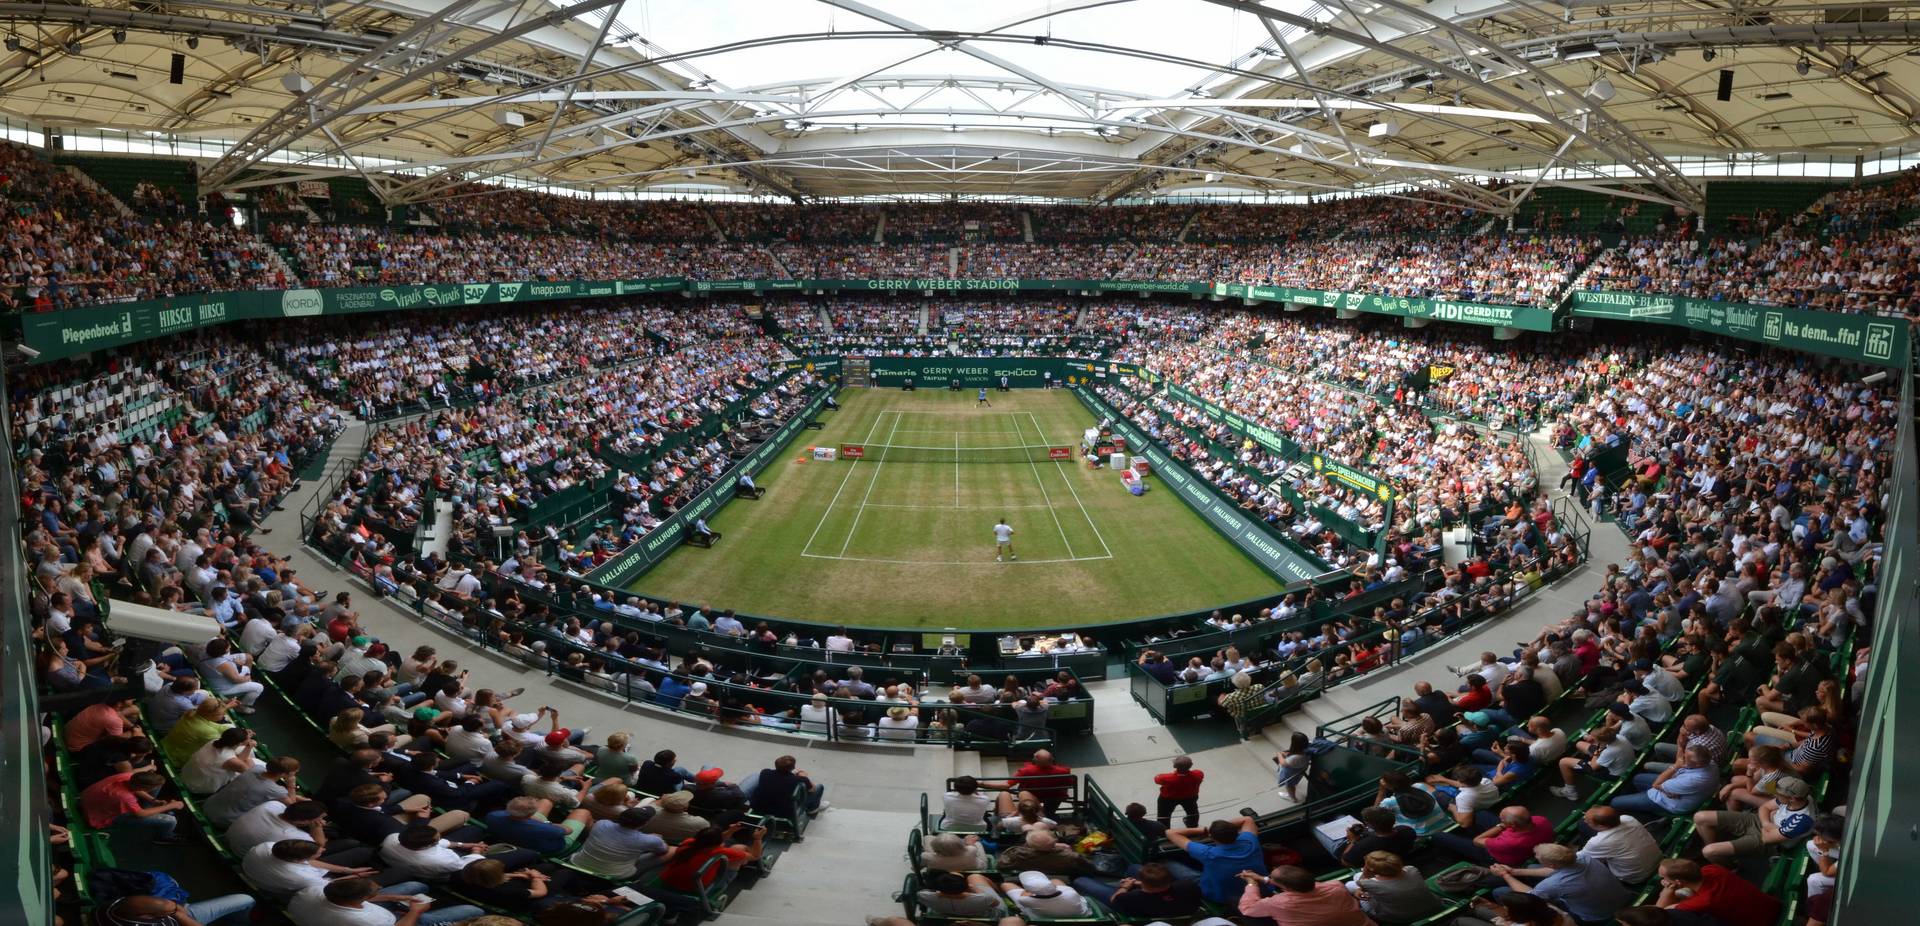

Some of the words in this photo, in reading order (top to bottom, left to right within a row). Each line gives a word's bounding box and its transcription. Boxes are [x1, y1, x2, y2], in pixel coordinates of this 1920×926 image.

[500, 287, 518, 298] SAP
[530, 284, 571, 296] knapp.com
[868, 280, 911, 290] GERRY
[916, 280, 961, 290] WEBER
[967, 280, 1020, 290] STADION
[465, 288, 485, 300] SAP
[1324, 295, 1337, 304] SAP
[1347, 297, 1361, 307] SAP
[1578, 292, 1673, 307] WESTFALEN-BLATT
[199, 302, 226, 320] HIRSCH
[286, 299, 320, 309] KORDA
[1435, 303, 1463, 320] HDI
[159, 307, 193, 328] HIRSCH
[62, 321, 120, 344] Piepenbrock
[1766, 319, 1779, 337] ffn
[1785, 321, 1799, 337] Na
[1801, 323, 1860, 346] denn...ffn!
[1868, 333, 1888, 355] ffn
[875, 367, 917, 376] Tamaris
[922, 367, 952, 375] GERRY
[956, 367, 989, 375] WEBER
[994, 367, 1037, 377] SCHÜCO
[1246, 424, 1282, 448] nobilia
[1213, 505, 1242, 530] HALLHUBER
[647, 522, 681, 551] HALLHUBER
[1245, 531, 1281, 560] HALLHUBER
[599, 553, 641, 585] HALLHUBER
